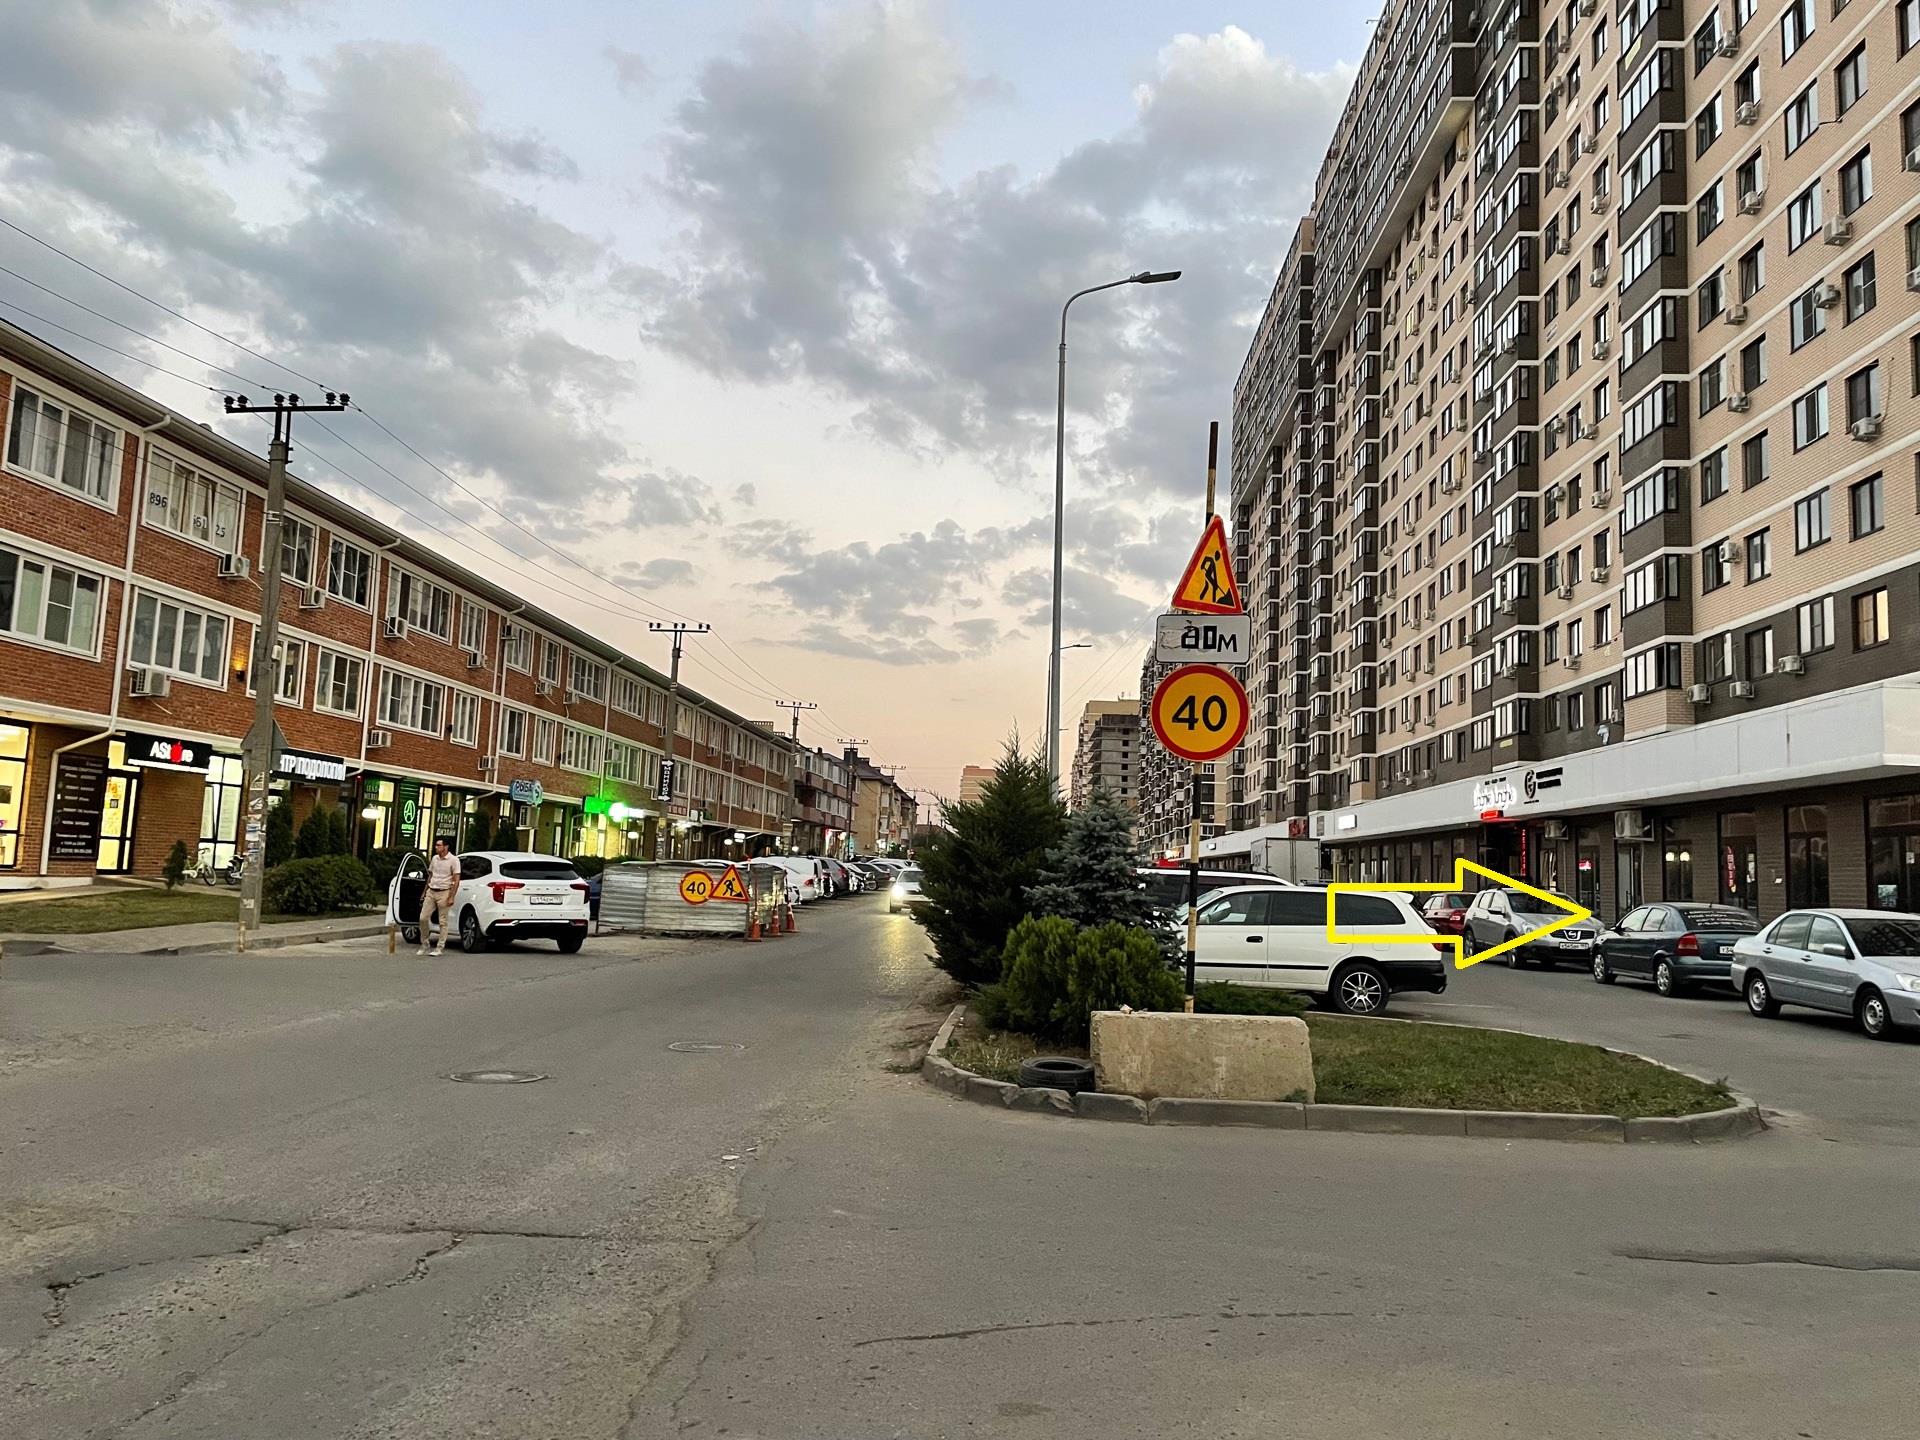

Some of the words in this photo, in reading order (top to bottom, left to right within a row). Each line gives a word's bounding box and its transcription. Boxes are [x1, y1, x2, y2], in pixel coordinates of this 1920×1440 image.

[149, 492, 168, 508] 896
[1171, 695, 1228, 732] 40
[686, 881, 706, 895] 40
